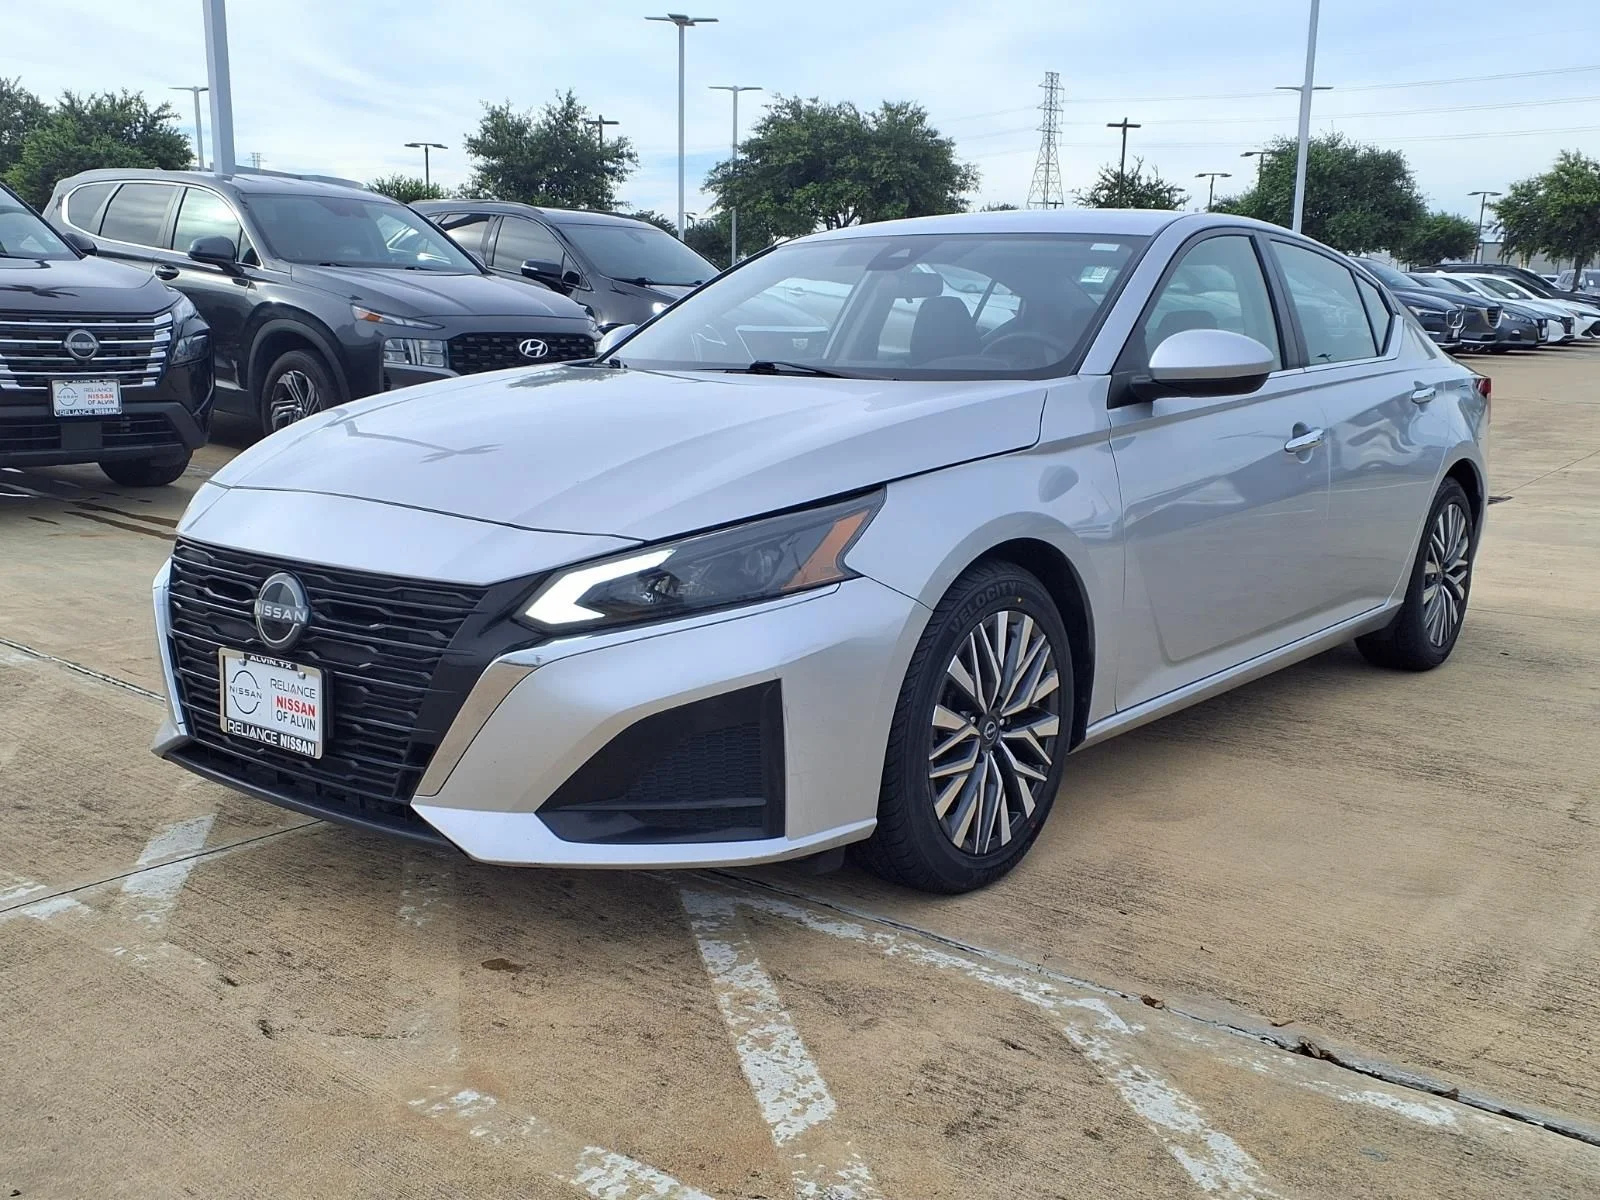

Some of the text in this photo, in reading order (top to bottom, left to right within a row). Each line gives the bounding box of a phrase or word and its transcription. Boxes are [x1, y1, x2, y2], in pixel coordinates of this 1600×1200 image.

[255, 603, 307, 623] NISSAN
[949, 581, 1017, 632] VELOCITY
[280, 661, 292, 670] TX
[229, 685, 262, 700] NISSAN
[270, 678, 316, 699] RELIANCE
[276, 695, 316, 717] NISSAN
[276, 709, 316, 731] OF ALVIN
[227, 719, 315, 756] RELIANCE NISSAN
